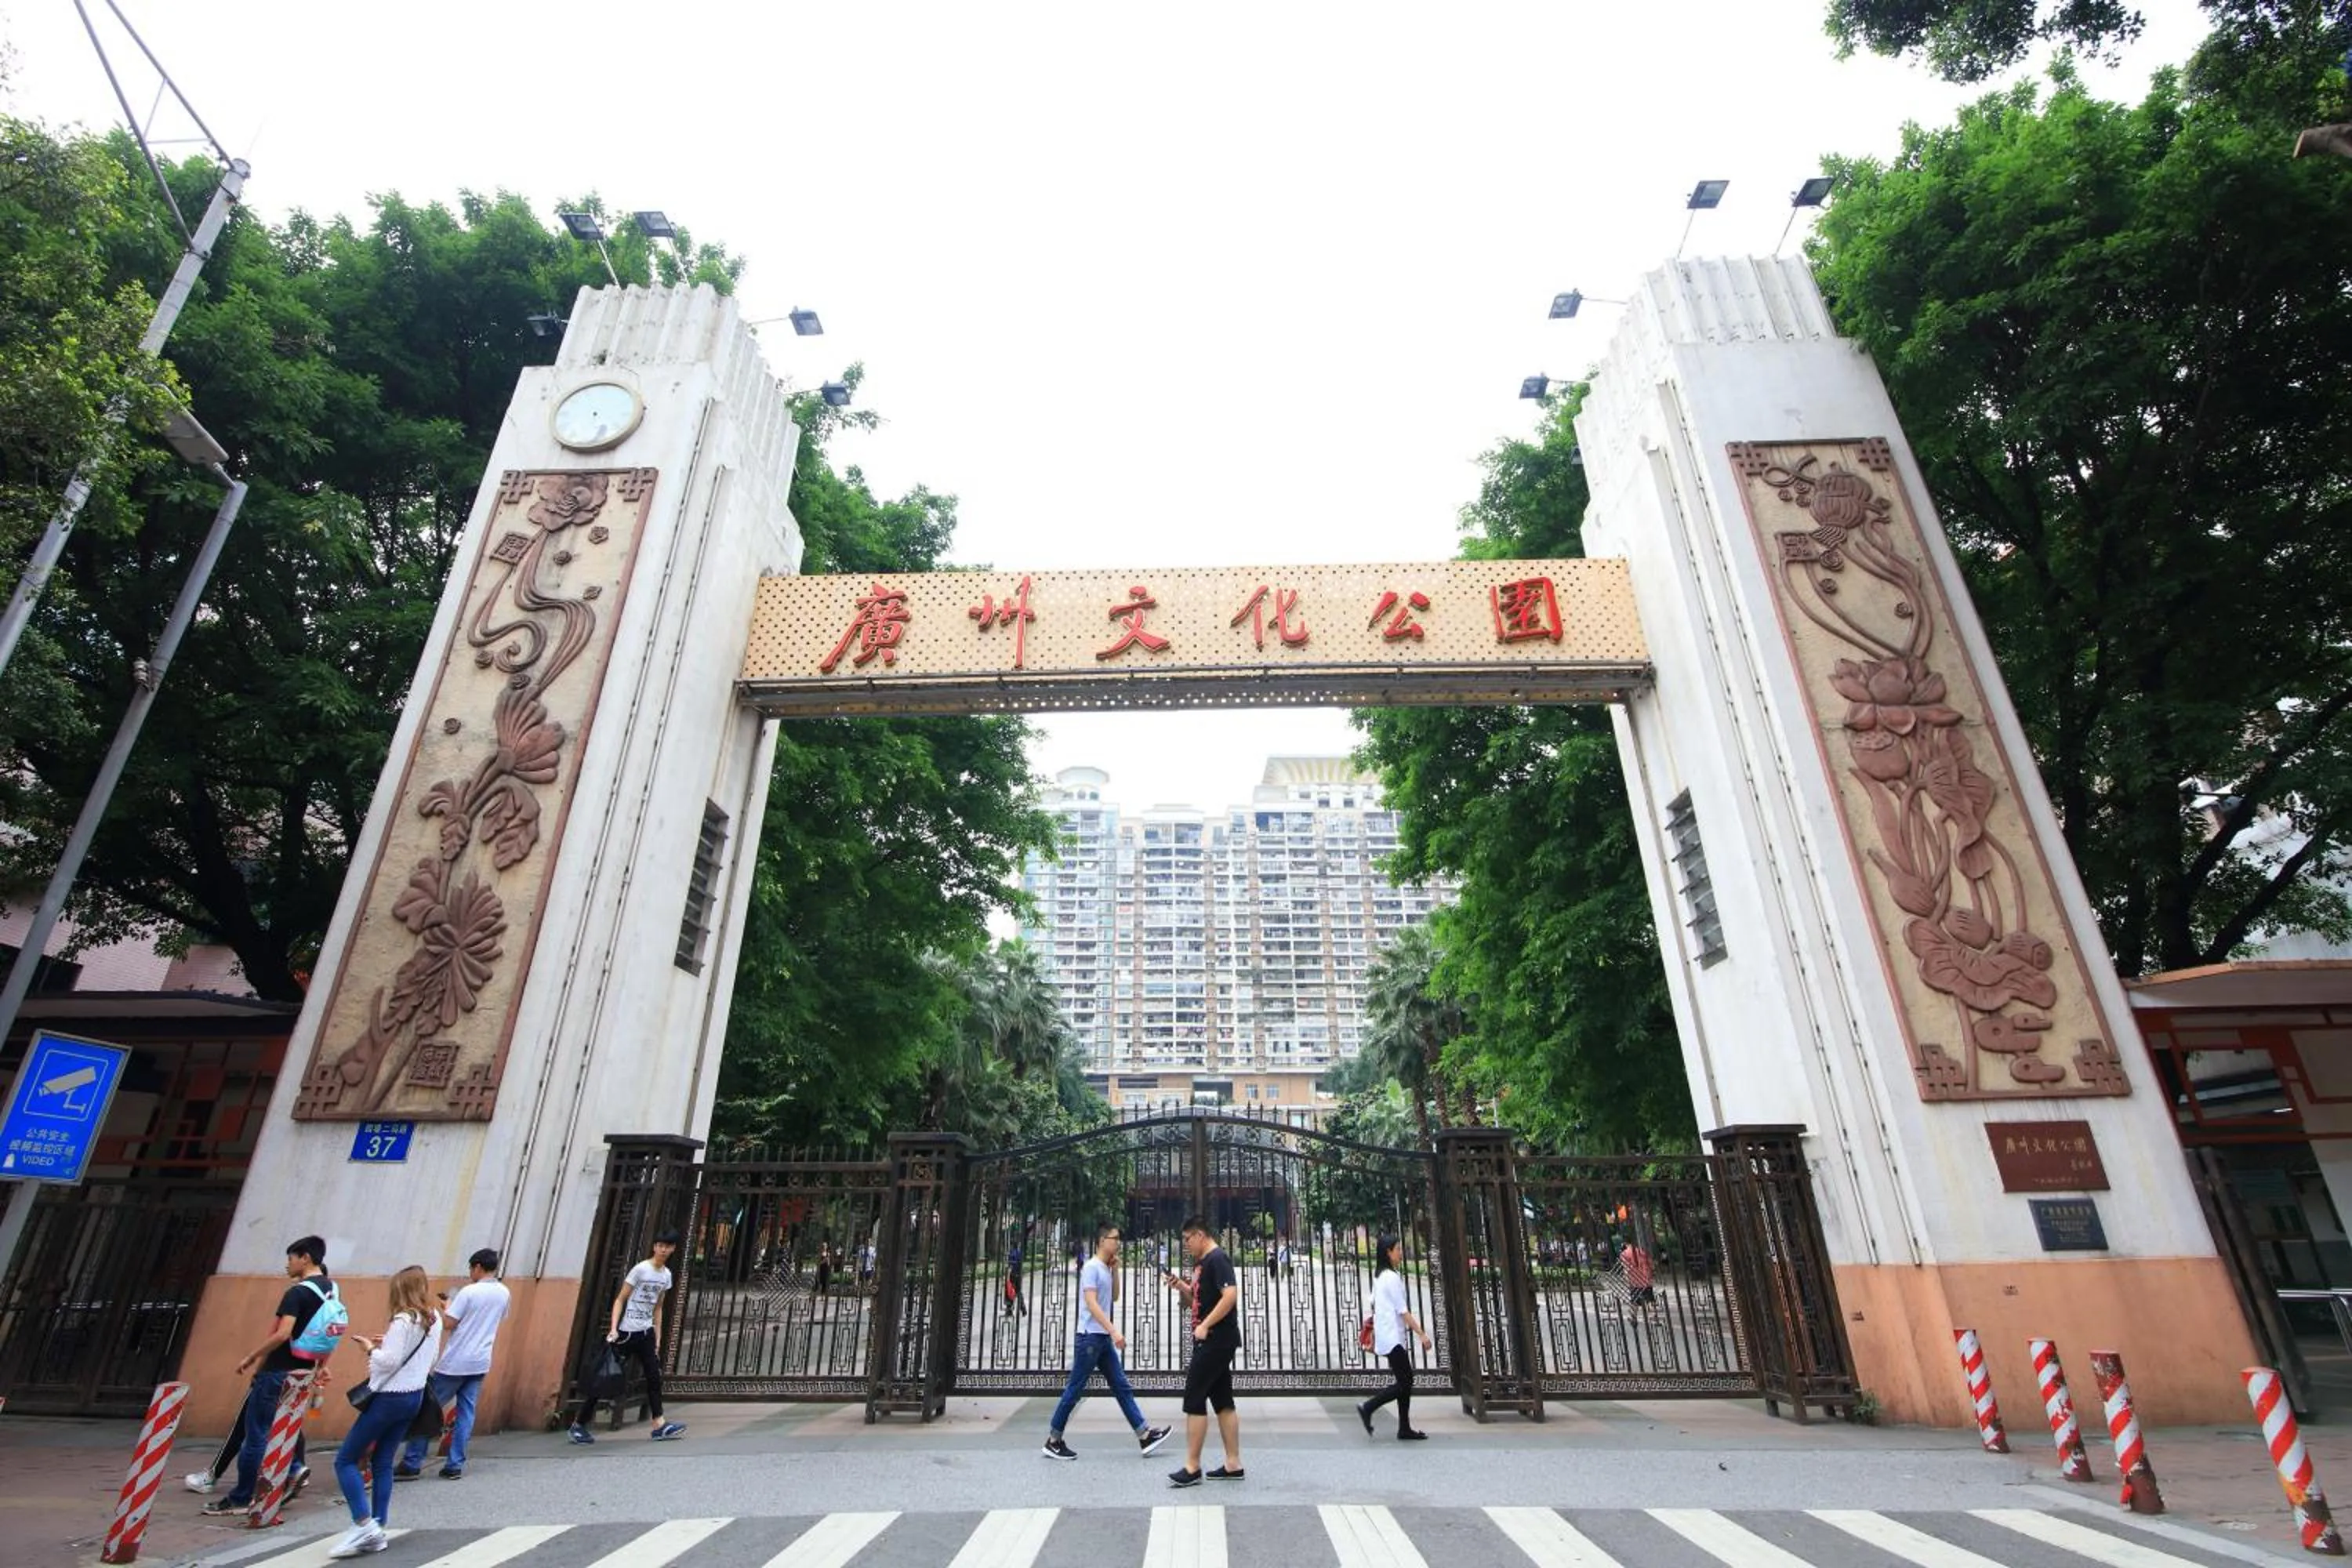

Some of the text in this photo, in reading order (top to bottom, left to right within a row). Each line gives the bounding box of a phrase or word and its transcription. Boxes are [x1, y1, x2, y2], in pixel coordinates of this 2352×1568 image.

[819, 575, 1564, 672] 廣州文化公園
[366, 1135, 397, 1158] 37
[23, 1154, 55, 1167] VIDEO
